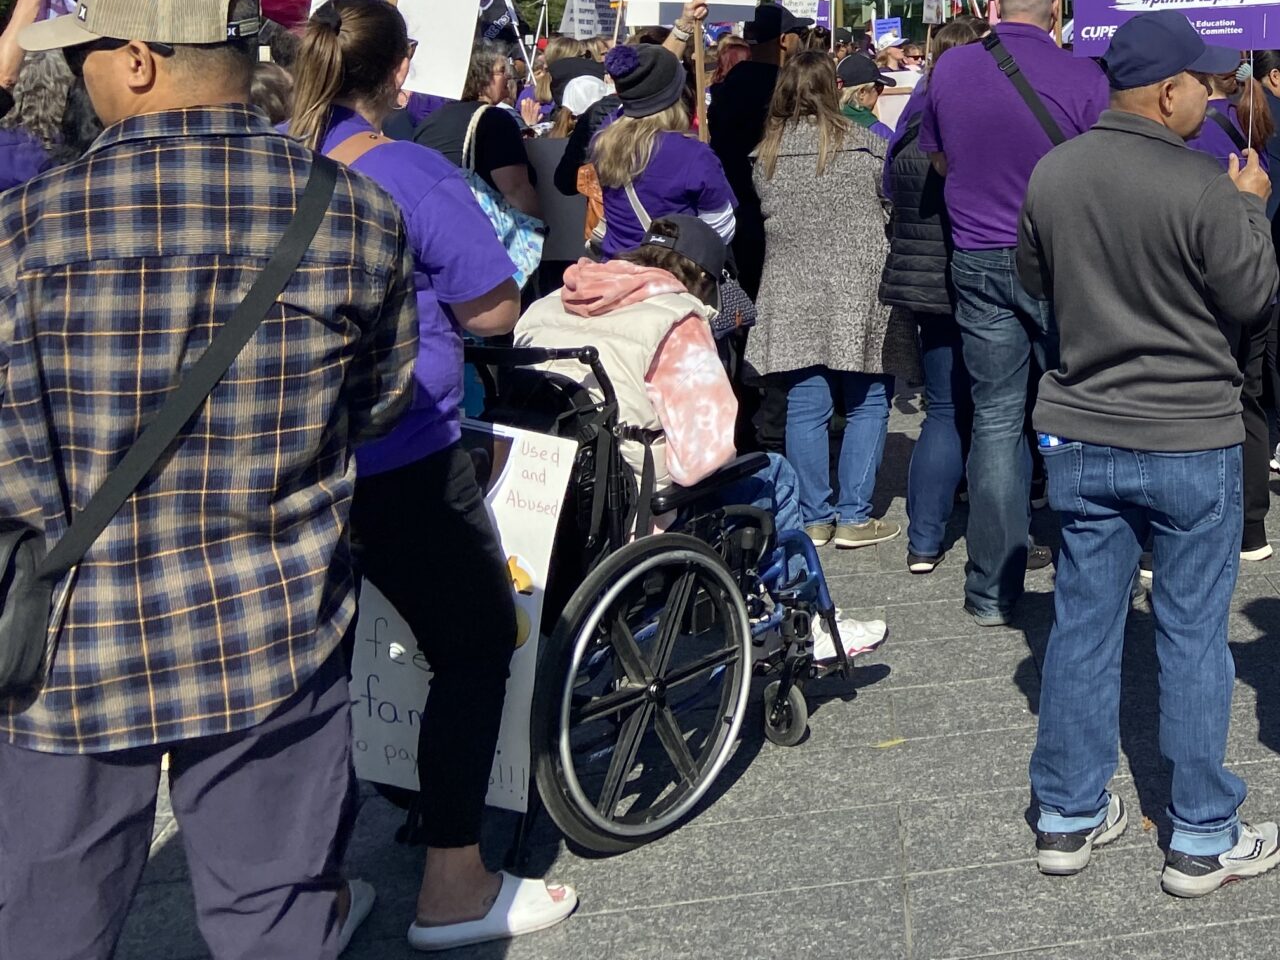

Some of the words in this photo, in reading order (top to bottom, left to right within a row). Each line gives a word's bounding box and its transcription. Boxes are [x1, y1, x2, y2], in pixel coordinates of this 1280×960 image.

[1081, 25, 1118, 38] CUPE
[1196, 20, 1236, 28] Education
[1200, 27, 1243, 35] Committee
[521, 441, 560, 467] Used
[521, 467, 546, 486] and
[505, 489, 559, 518] Abused
